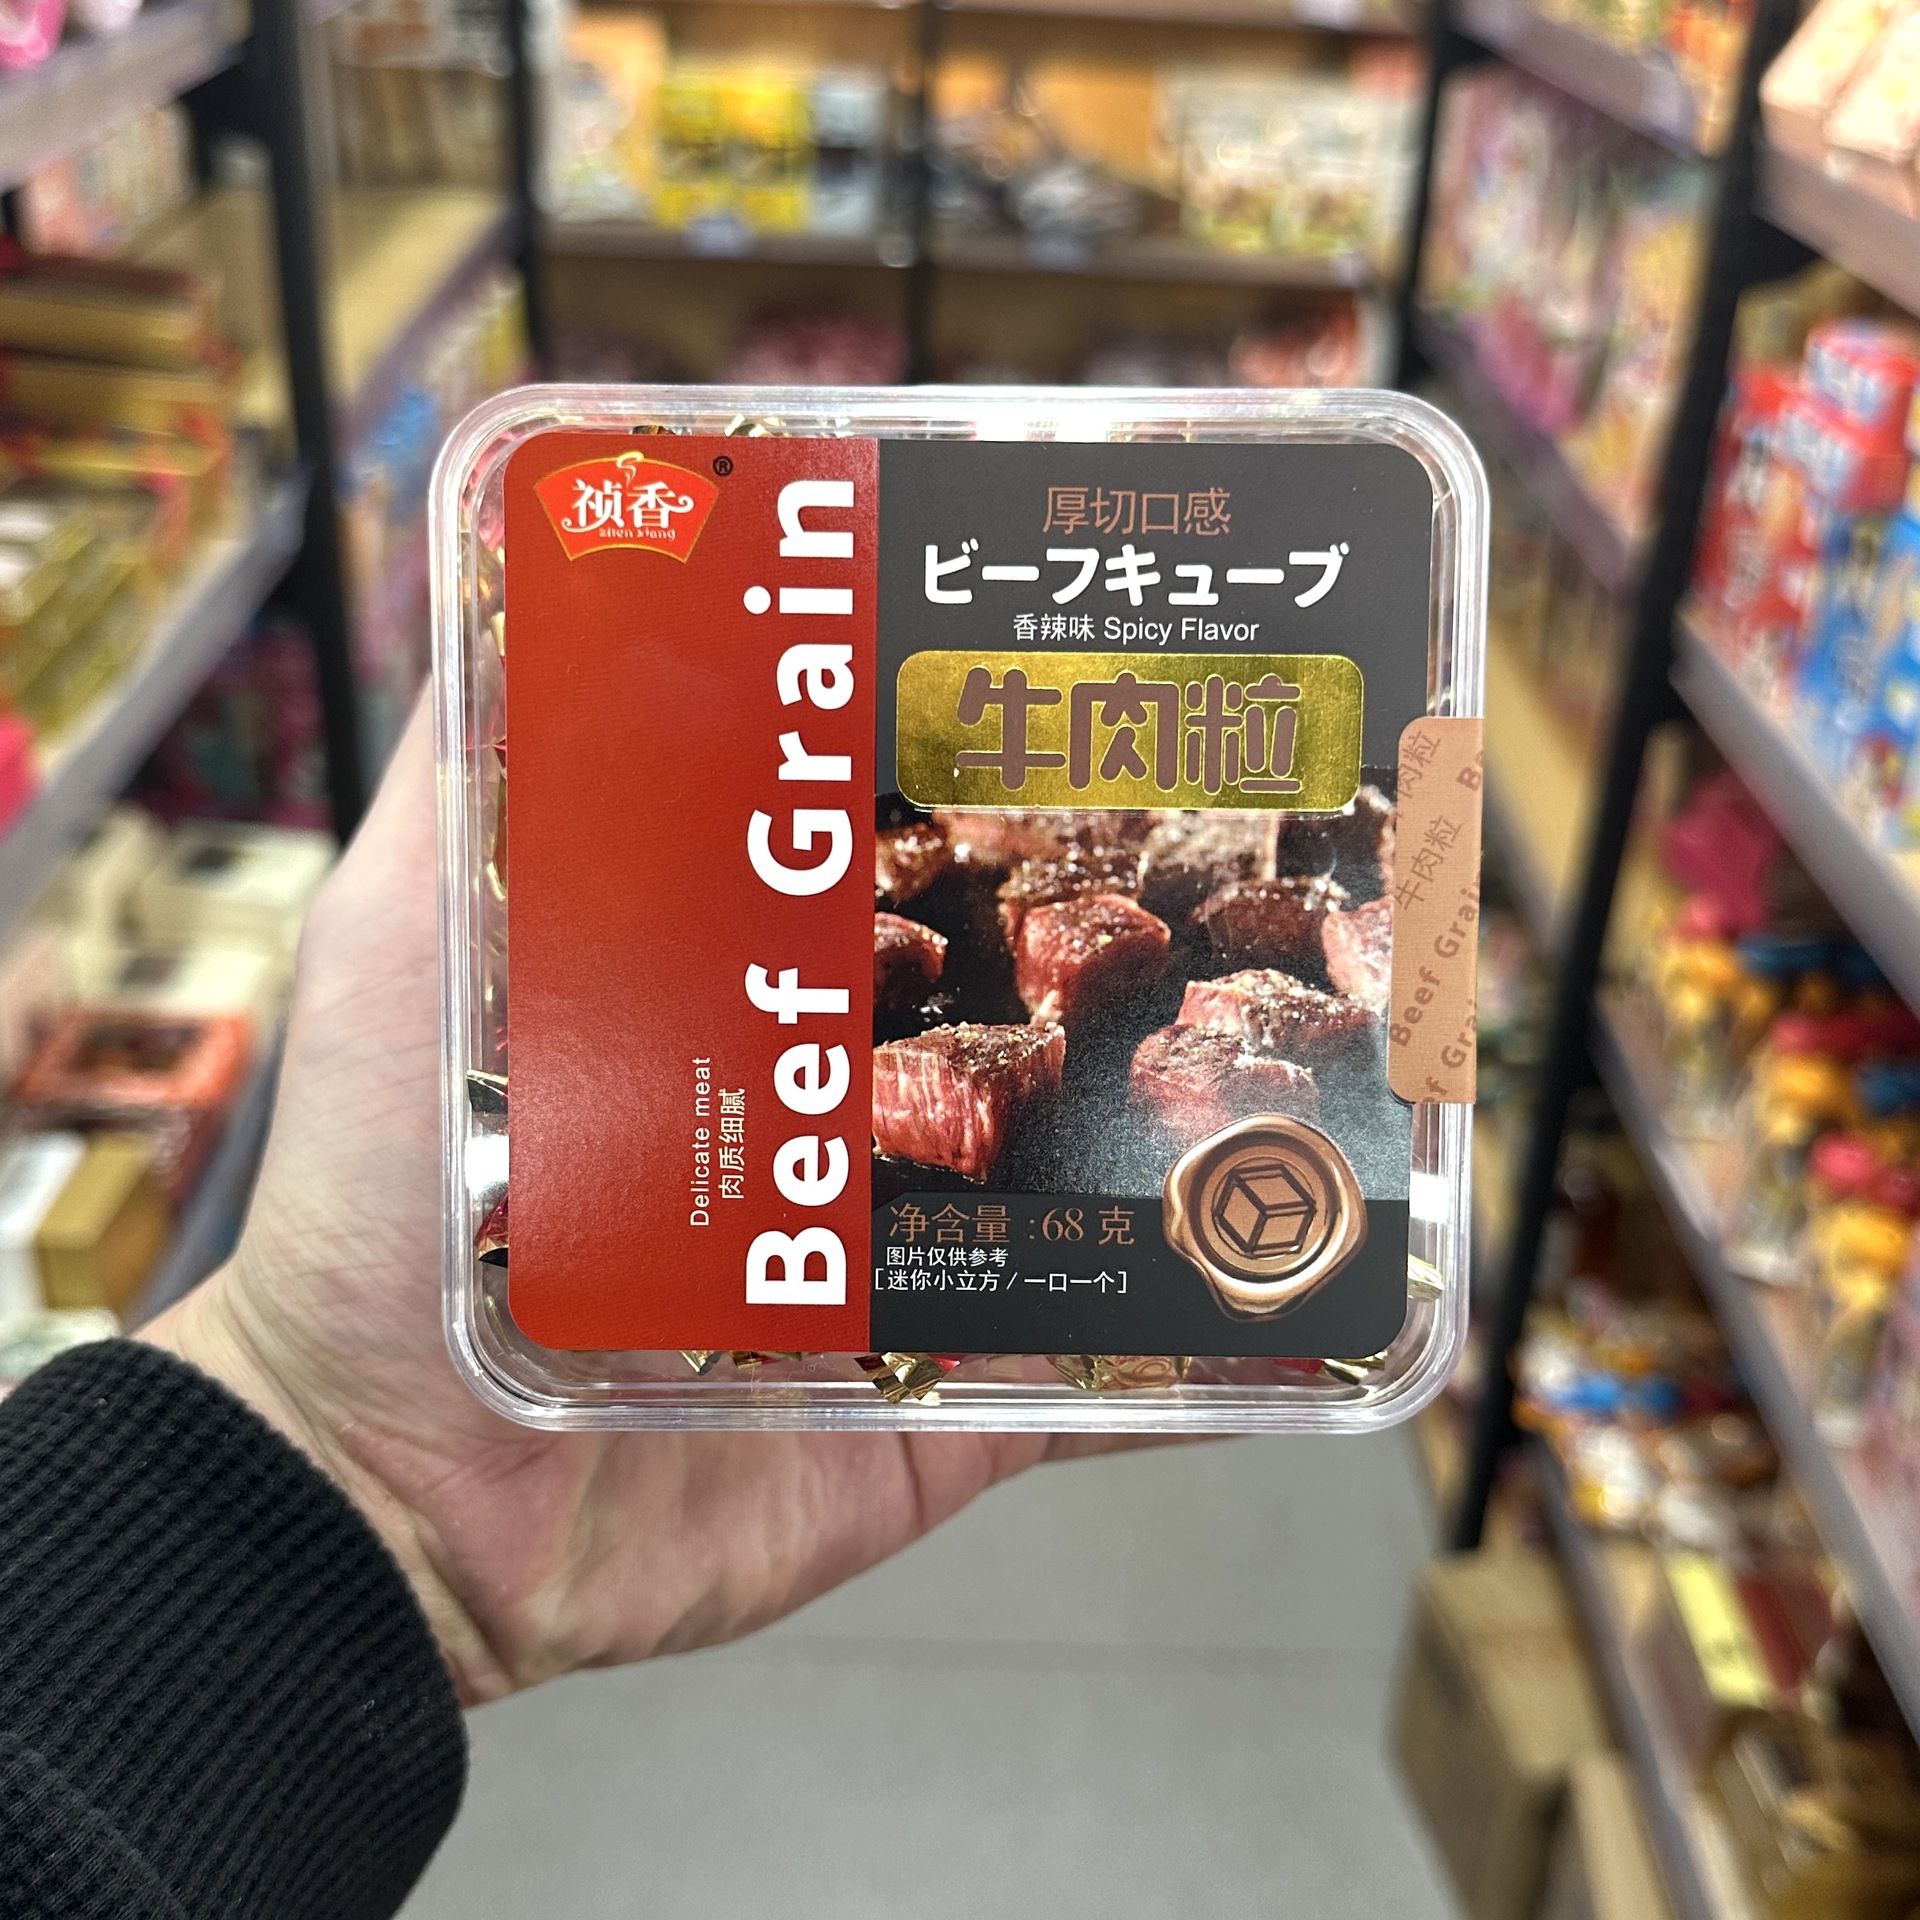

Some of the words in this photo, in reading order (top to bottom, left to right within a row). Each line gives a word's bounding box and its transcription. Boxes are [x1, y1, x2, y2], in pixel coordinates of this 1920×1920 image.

[561, 478, 695, 533] 祯香
[636, 527, 676, 542] xiang
[1042, 486, 1231, 536] 厚切口感
[924, 537, 1350, 608] ビーフキューブ
[1013, 612, 1095, 642] 香辣味
[1103, 616, 1173, 644] Spicy
[1180, 617, 1260, 642] Flavor
[743, 480, 854, 897] Grain
[955, 666, 1302, 796] 牛肉粒
[1394, 815, 1463, 910] 牛肉粒
[1389, 965, 1441, 1047] Beef
[691, 1056, 711, 1117] meat
[717, 1087, 746, 1199] 肉质细腻
[744, 963, 851, 1305] Beef
[690, 1126, 711, 1227] Delicate
[885, 1246, 1009, 1268] 图片仅供参考
[888, 1201, 1011, 1244] 净含量
[1097, 1204, 1136, 1246] 克
